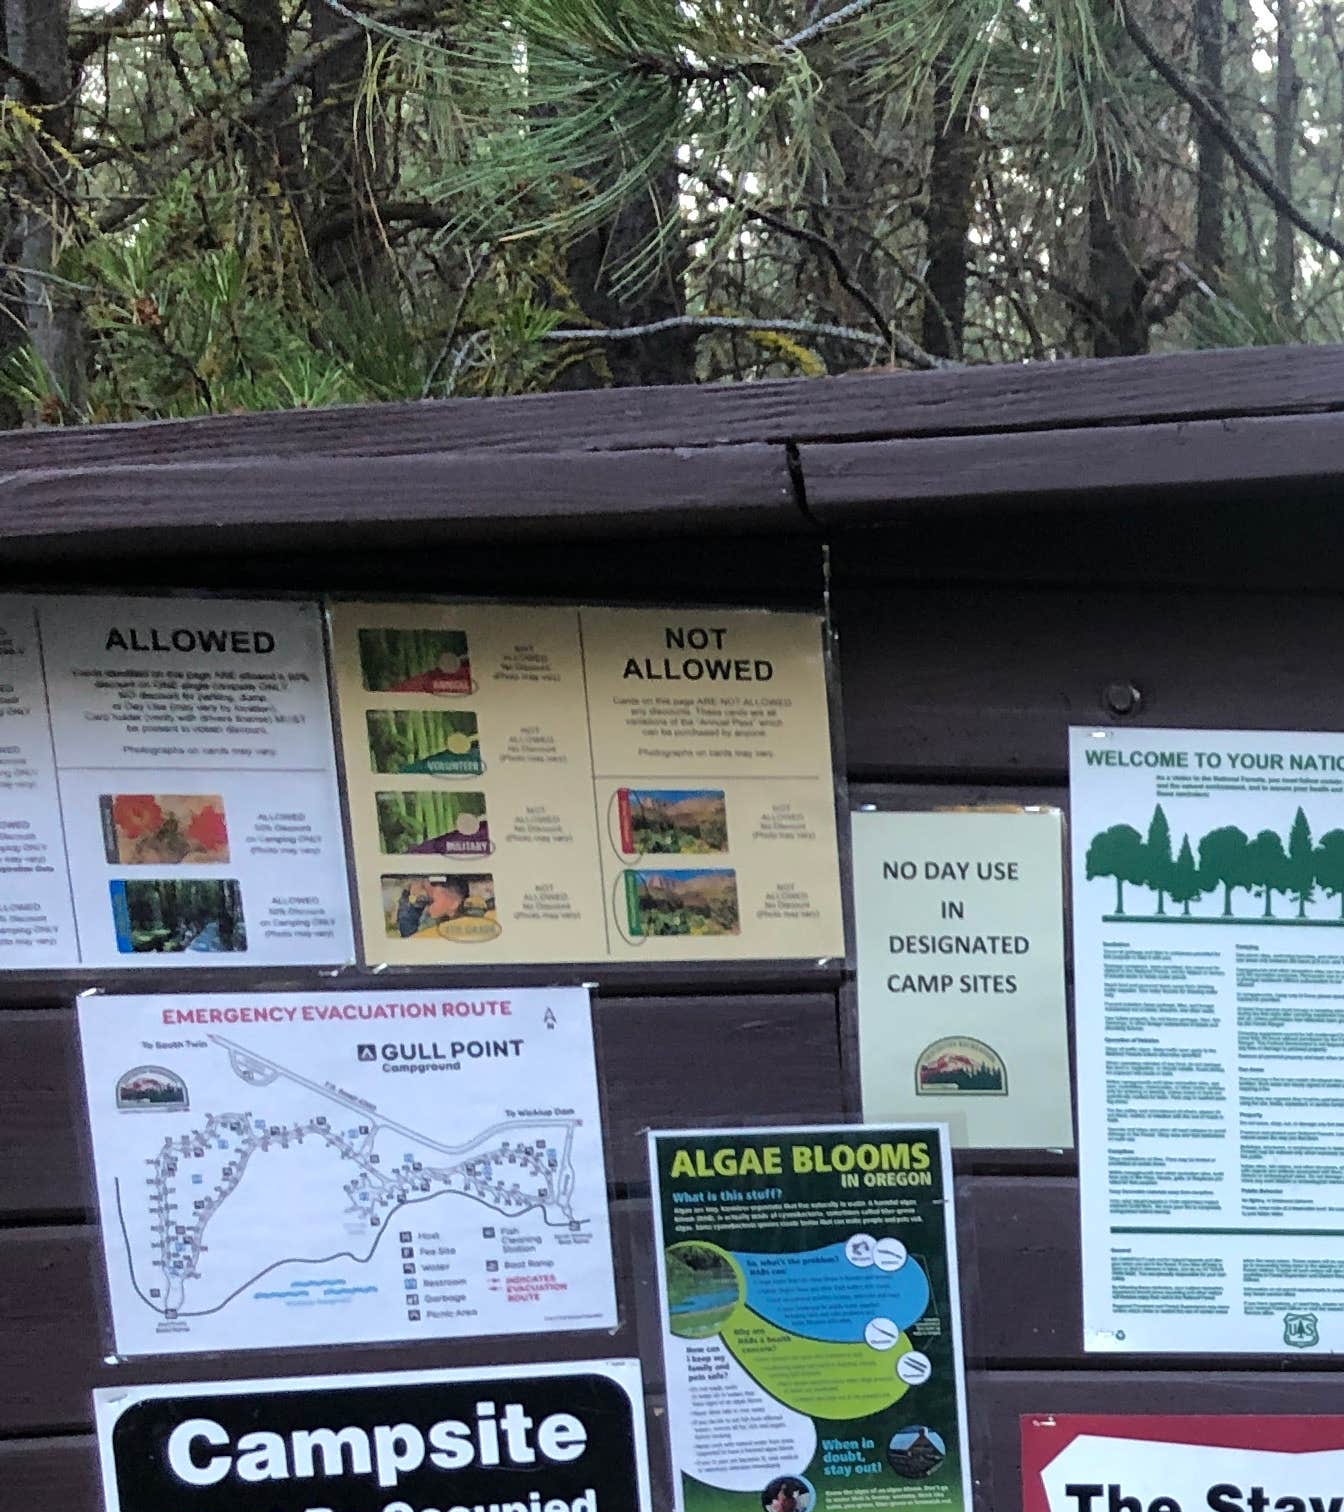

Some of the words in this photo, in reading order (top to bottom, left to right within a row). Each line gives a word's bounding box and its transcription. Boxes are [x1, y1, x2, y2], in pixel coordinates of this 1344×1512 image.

[105, 627, 275, 654] ALLOWED
[664, 626, 727, 651] NOT
[623, 657, 773, 682] ALLOWED
[1084, 749, 1189, 768] WELCOME
[1194, 751, 1222, 769] TO
[1226, 752, 1284, 771] YOUR
[883, 861, 917, 880] NO
[924, 861, 970, 881] DAY
[976, 861, 1019, 881] USE
[941, 901, 964, 919] IN
[889, 935, 1030, 955] DESIGNATED
[887, 974, 954, 993] CAMP
[959, 974, 1018, 994] SITES
[162, 1006, 298, 1025] EMERGENCY
[301, 1002, 437, 1022] EVACUATION
[445, 1000, 513, 1018] ROUTE
[381, 1042, 447, 1062] GULL
[450, 1038, 525, 1059] POINT
[381, 1061, 461, 1075] Campground
[670, 1146, 783, 1178] ALGAE
[791, 1142, 930, 1174] BLOOMS
[841, 1172, 860, 1189] IN
[863, 1171, 932, 1188] OREGON
[672, 1191, 705, 1204] What
[704, 1190, 717, 1202] is
[719, 1189, 744, 1202] this
[745, 1187, 783, 1201] stuff?
[167, 1401, 588, 1488] Campsite
[821, 1438, 860, 1451] When
[861, 1436, 875, 1449] in
[822, 1450, 866, 1464] doubt,
[823, 1464, 852, 1478] stay
